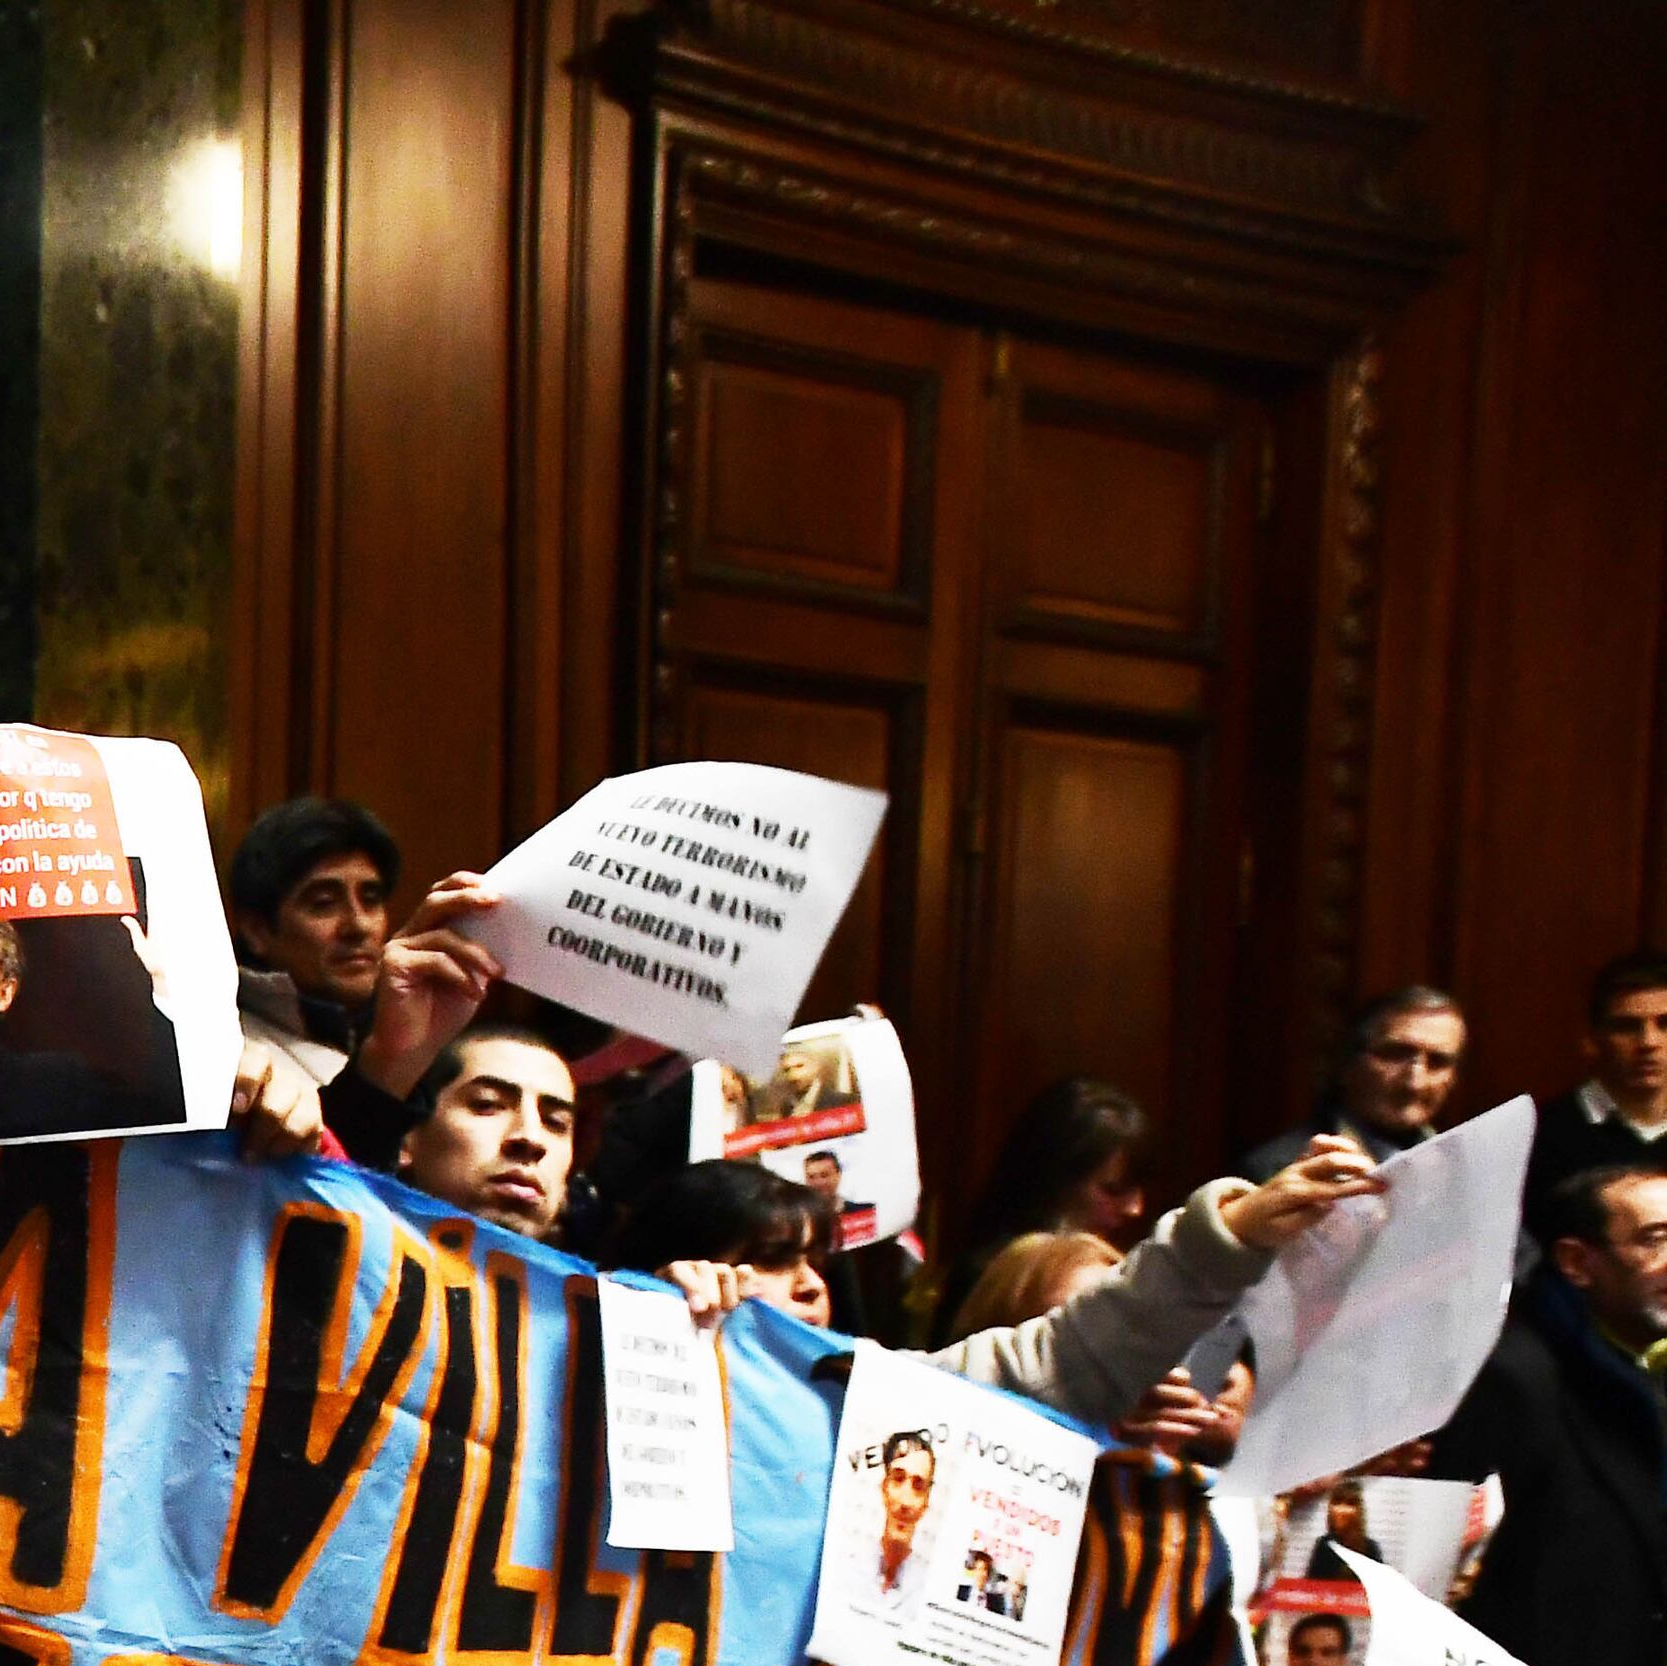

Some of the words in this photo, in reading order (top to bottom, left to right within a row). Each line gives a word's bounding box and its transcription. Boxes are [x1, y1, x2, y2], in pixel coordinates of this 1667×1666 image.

[74, 819, 98, 839] de
[32, 850, 53, 872] la
[57, 850, 115, 876] ayuda
[567, 888, 606, 920] DEL
